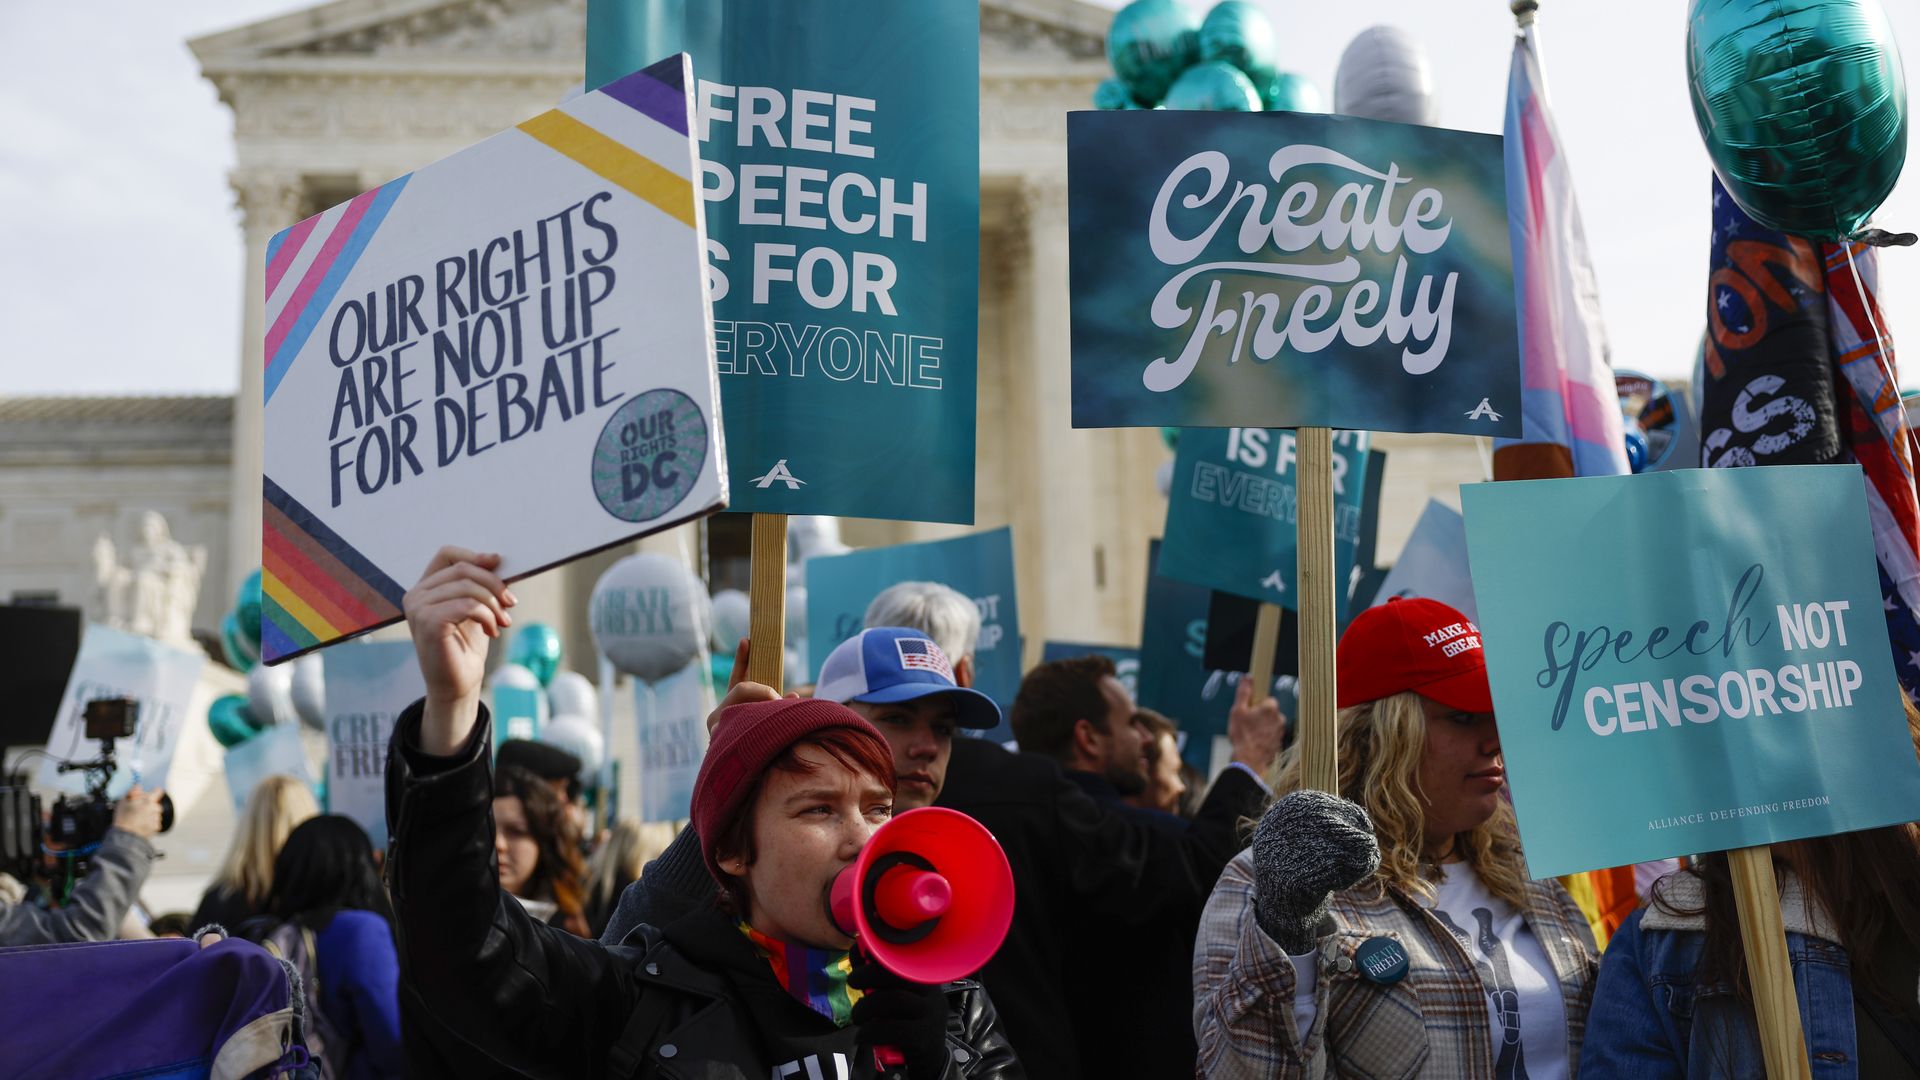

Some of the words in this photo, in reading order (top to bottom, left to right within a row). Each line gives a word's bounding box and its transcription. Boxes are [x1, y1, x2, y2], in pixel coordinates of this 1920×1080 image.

[698, 79, 876, 159] FREE
[1149, 144, 1453, 265] Create
[329, 274, 428, 368] OUR
[436, 191, 619, 327] RIGHTS
[752, 243, 899, 316] FOR
[329, 340, 422, 441] ARE
[433, 295, 530, 397] NOT
[541, 265, 616, 350] UP
[1142, 254, 1459, 392] Freely
[330, 412, 424, 508] FOR
[434, 327, 625, 468] DEBATE
[621, 409, 675, 447] OUR
[621, 434, 677, 463] RIGHTS
[622, 451, 679, 502] DC
[1275, 433, 1349, 495] FR
[1423, 622, 1467, 647] MAKE
[1536, 563, 1771, 731] speech
[1776, 600, 1849, 651] NOT
[1583, 659, 1863, 736] CENSORSHIP
[1648, 813, 1704, 831] ALLIANCE
[1710, 803, 1779, 821] DEFENDING
[1782, 795, 1830, 811] FREEDOM
[1368, 953, 1404, 977] FREELY
